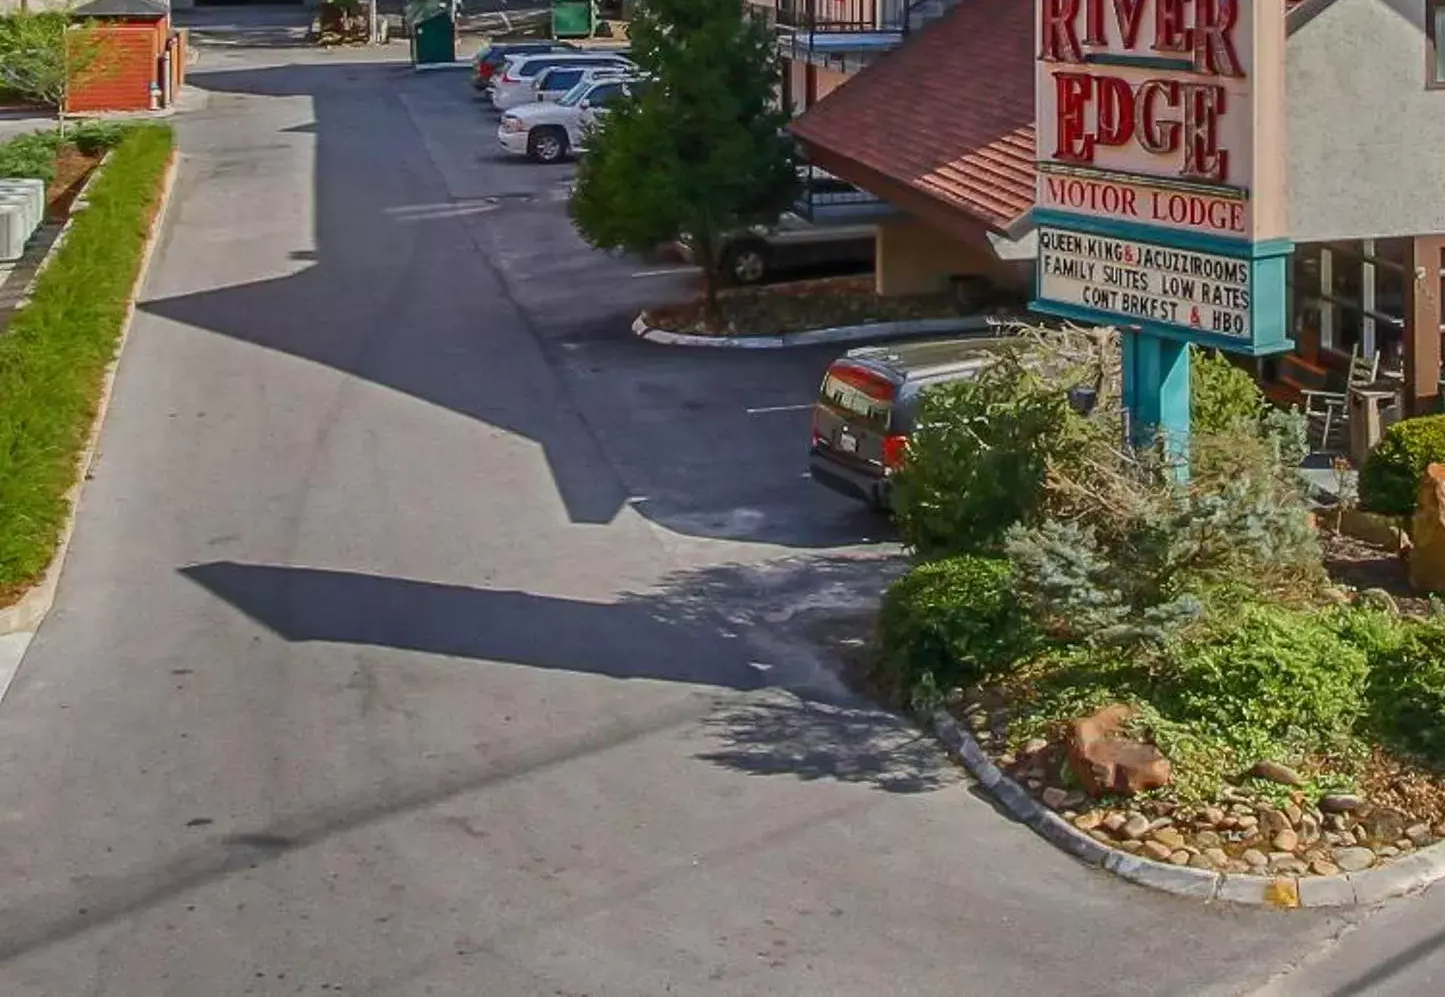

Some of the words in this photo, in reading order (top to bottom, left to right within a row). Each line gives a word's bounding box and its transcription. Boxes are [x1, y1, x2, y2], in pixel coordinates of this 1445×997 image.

[1051, 71, 1229, 182] EDGE
[1048, 178, 1138, 216] MOTOR
[1151, 191, 1245, 232] LODGE
[1044, 255, 1095, 281] FAMILY
[1103, 266, 1149, 291] SUITES
[1162, 274, 1195, 299] LOW
[1202, 282, 1249, 309] RATES
[1083, 285, 1117, 309] CONT
[1122, 293, 1178, 323] BRKFST
[1190, 305, 1200, 324] &
[1212, 310, 1244, 334] HBO
